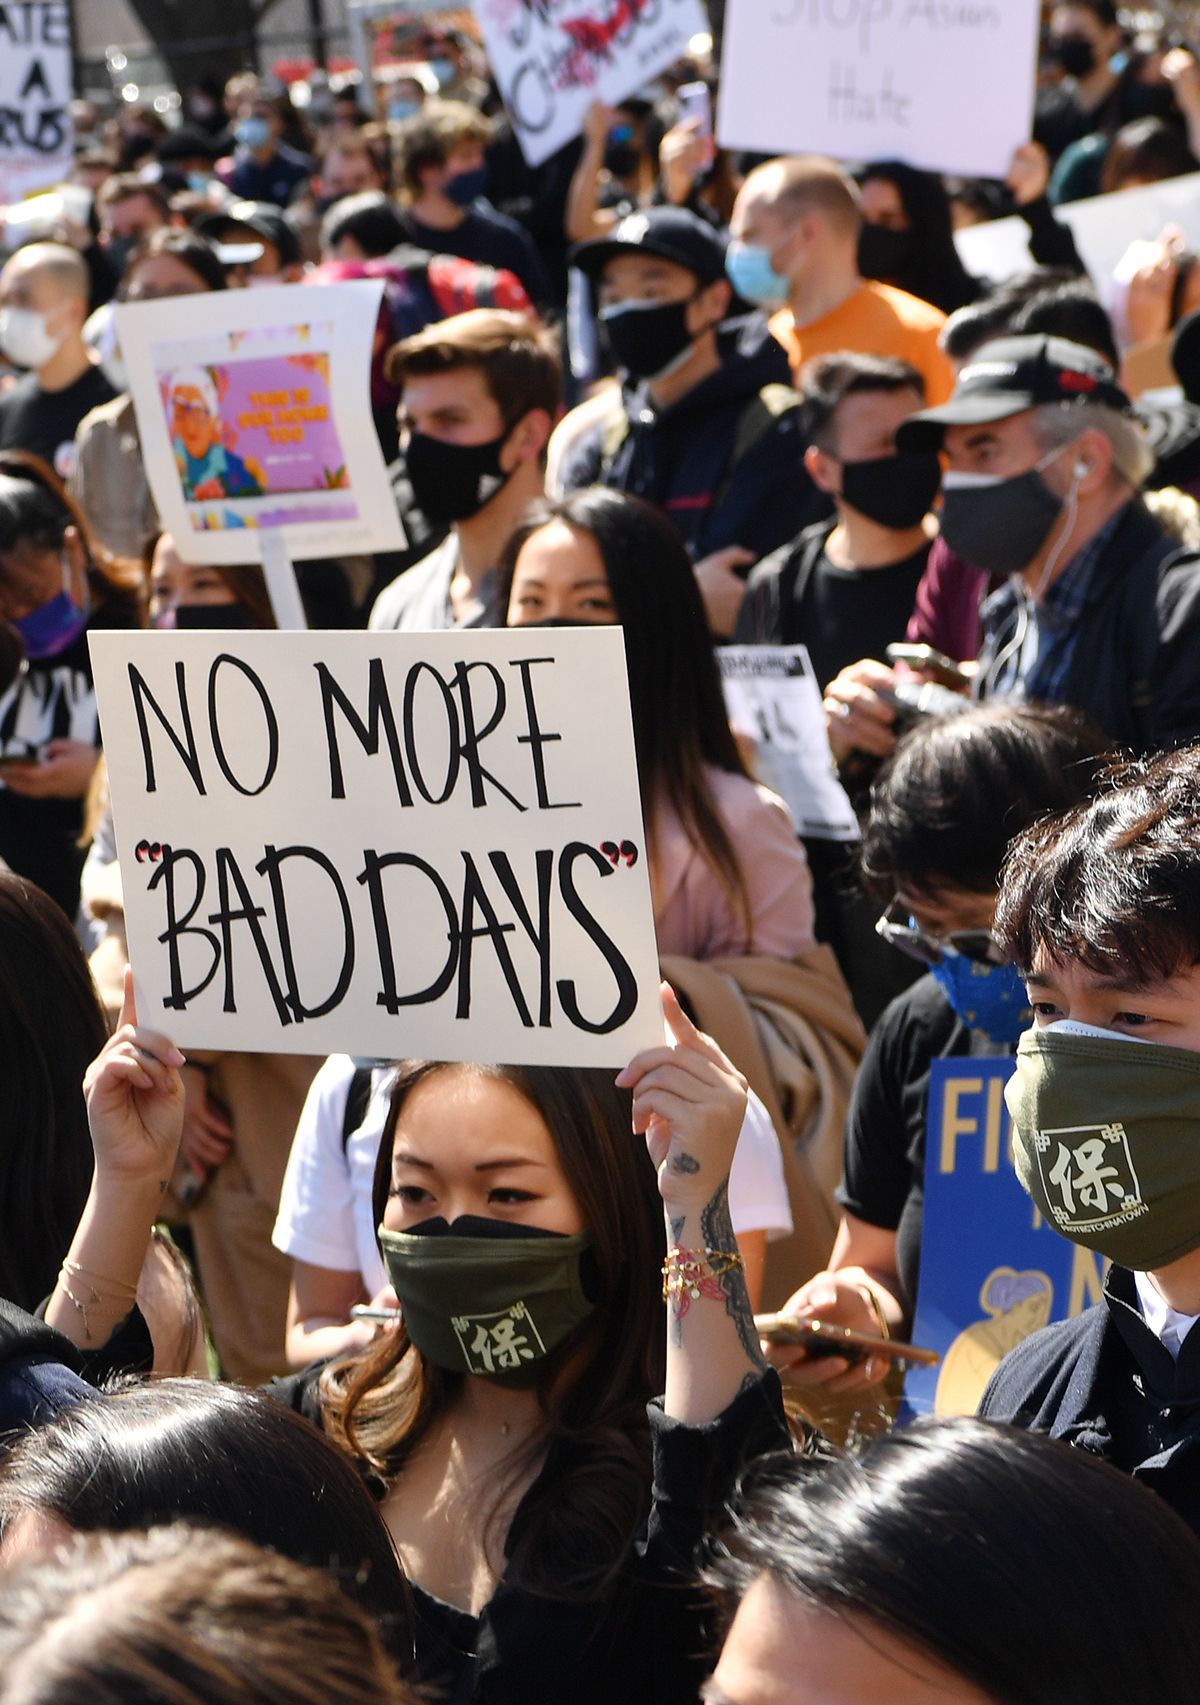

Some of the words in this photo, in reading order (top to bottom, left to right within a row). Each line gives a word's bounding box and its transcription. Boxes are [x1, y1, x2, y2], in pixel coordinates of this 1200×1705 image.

[19, 58, 50, 99] A
[128, 653, 279, 797] NO
[313, 657, 583, 812] MORE
[1049, 1138, 1126, 1214] 保
[471, 1318, 535, 1372] 保
